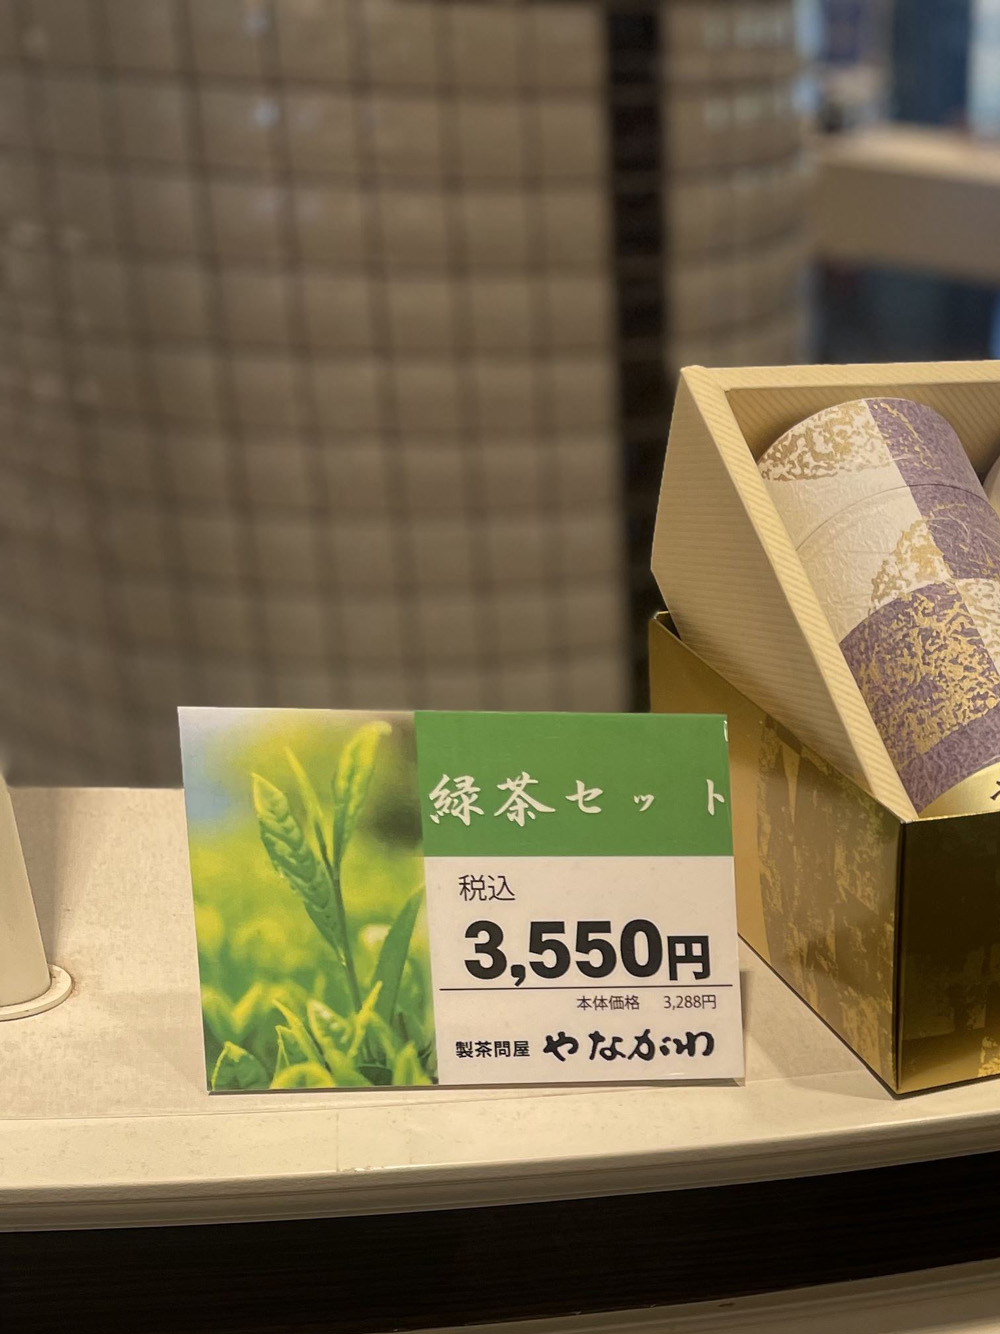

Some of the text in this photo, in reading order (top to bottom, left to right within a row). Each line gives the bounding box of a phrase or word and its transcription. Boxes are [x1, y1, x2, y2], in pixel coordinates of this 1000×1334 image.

[428, 771, 726, 827] 緑茶セット
[457, 874, 516, 902] 税込
[463, 918, 712, 987] 3,550円
[576, 993, 717, 1012] 本体価格 3,288円
[454, 1029, 715, 1063] 製茶問屋 やながわ
